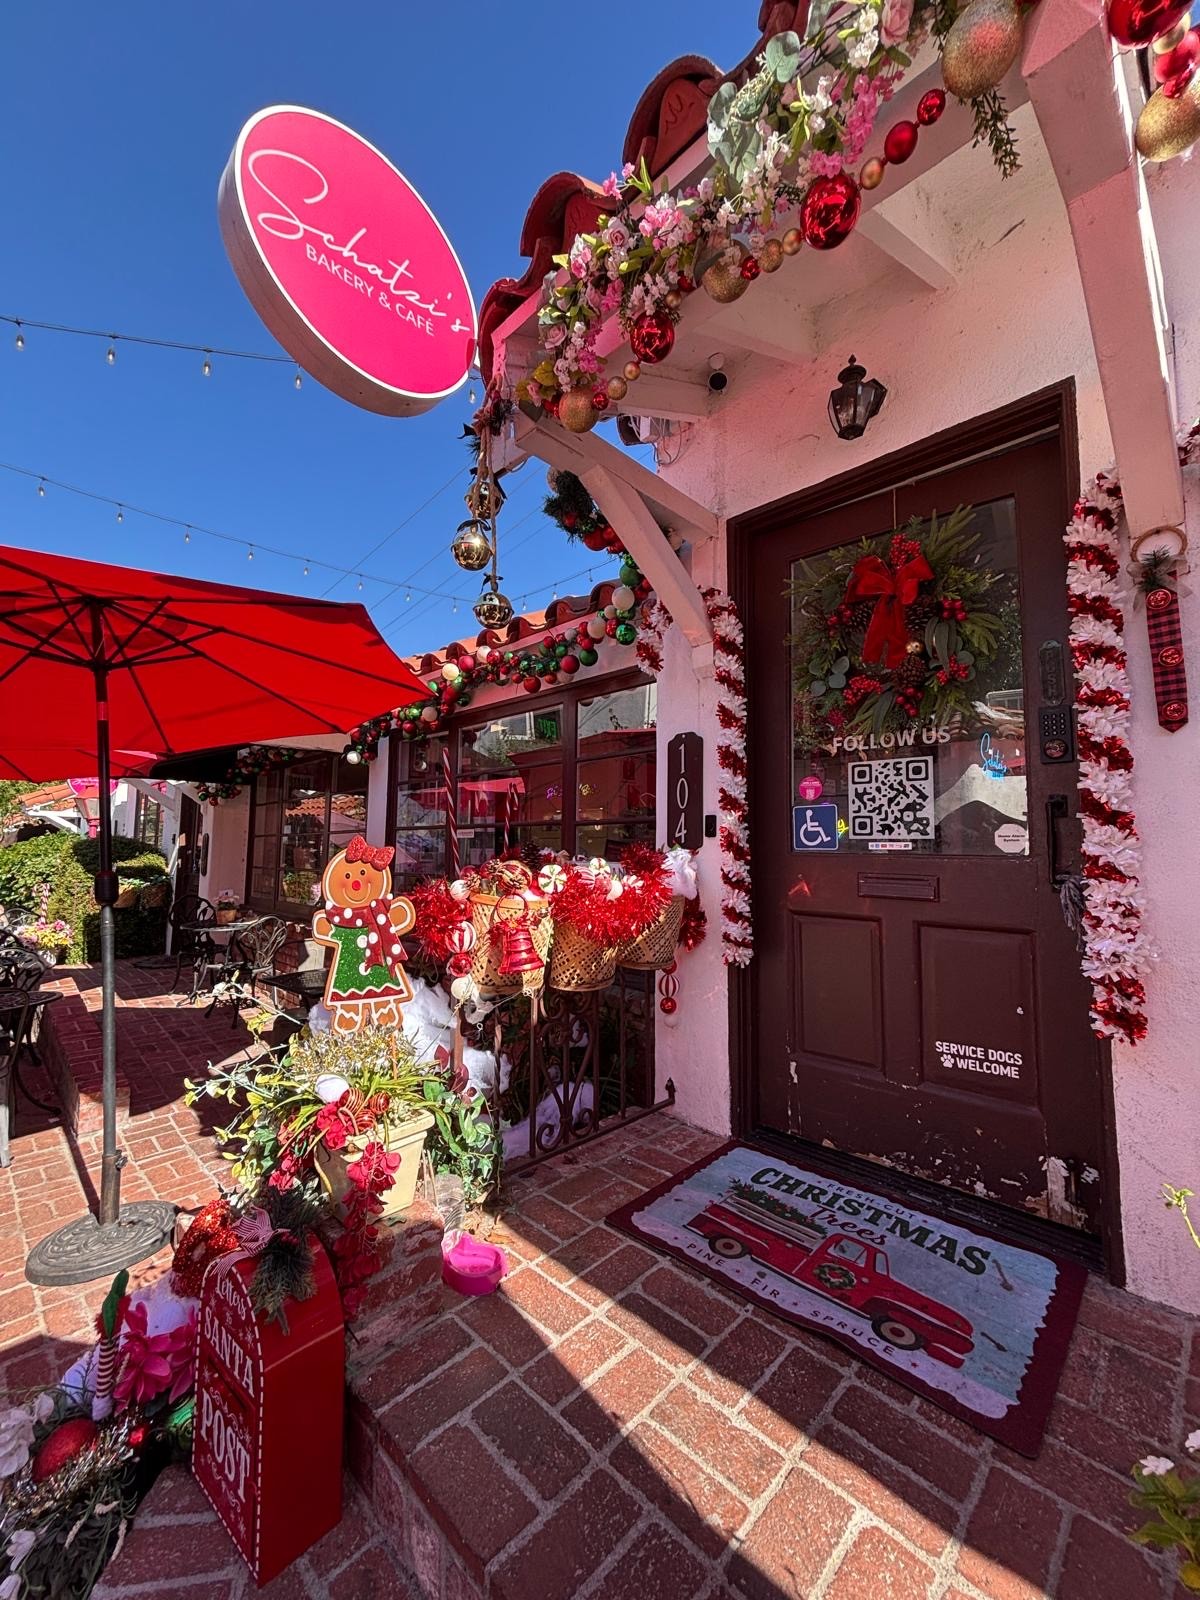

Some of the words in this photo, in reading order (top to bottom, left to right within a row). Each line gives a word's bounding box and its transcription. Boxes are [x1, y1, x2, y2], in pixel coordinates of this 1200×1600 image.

[248, 149, 470, 332] Schatzi's
[305, 243, 374, 299] BAKERY
[378, 292, 392, 311] &
[832, 728, 917, 752] FOLLOW
[922, 726, 952, 745] US
[675, 743, 688, 844] 104
[935, 1040, 985, 1060] SERVICE
[988, 1048, 1023, 1066] DOGS
[956, 1056, 1020, 1079] WELCOME
[750, 1166, 992, 1276] CHRISTMAS
[809, 1204, 887, 1246] Trees
[686, 1243, 727, 1268] PINE
[215, 1272, 247, 1321] Letters
[750, 1277, 781, 1299] FIR
[204, 1305, 256, 1399] SANTA
[809, 1309, 897, 1357] SPRUCE
[200, 1388, 251, 1504] POST
